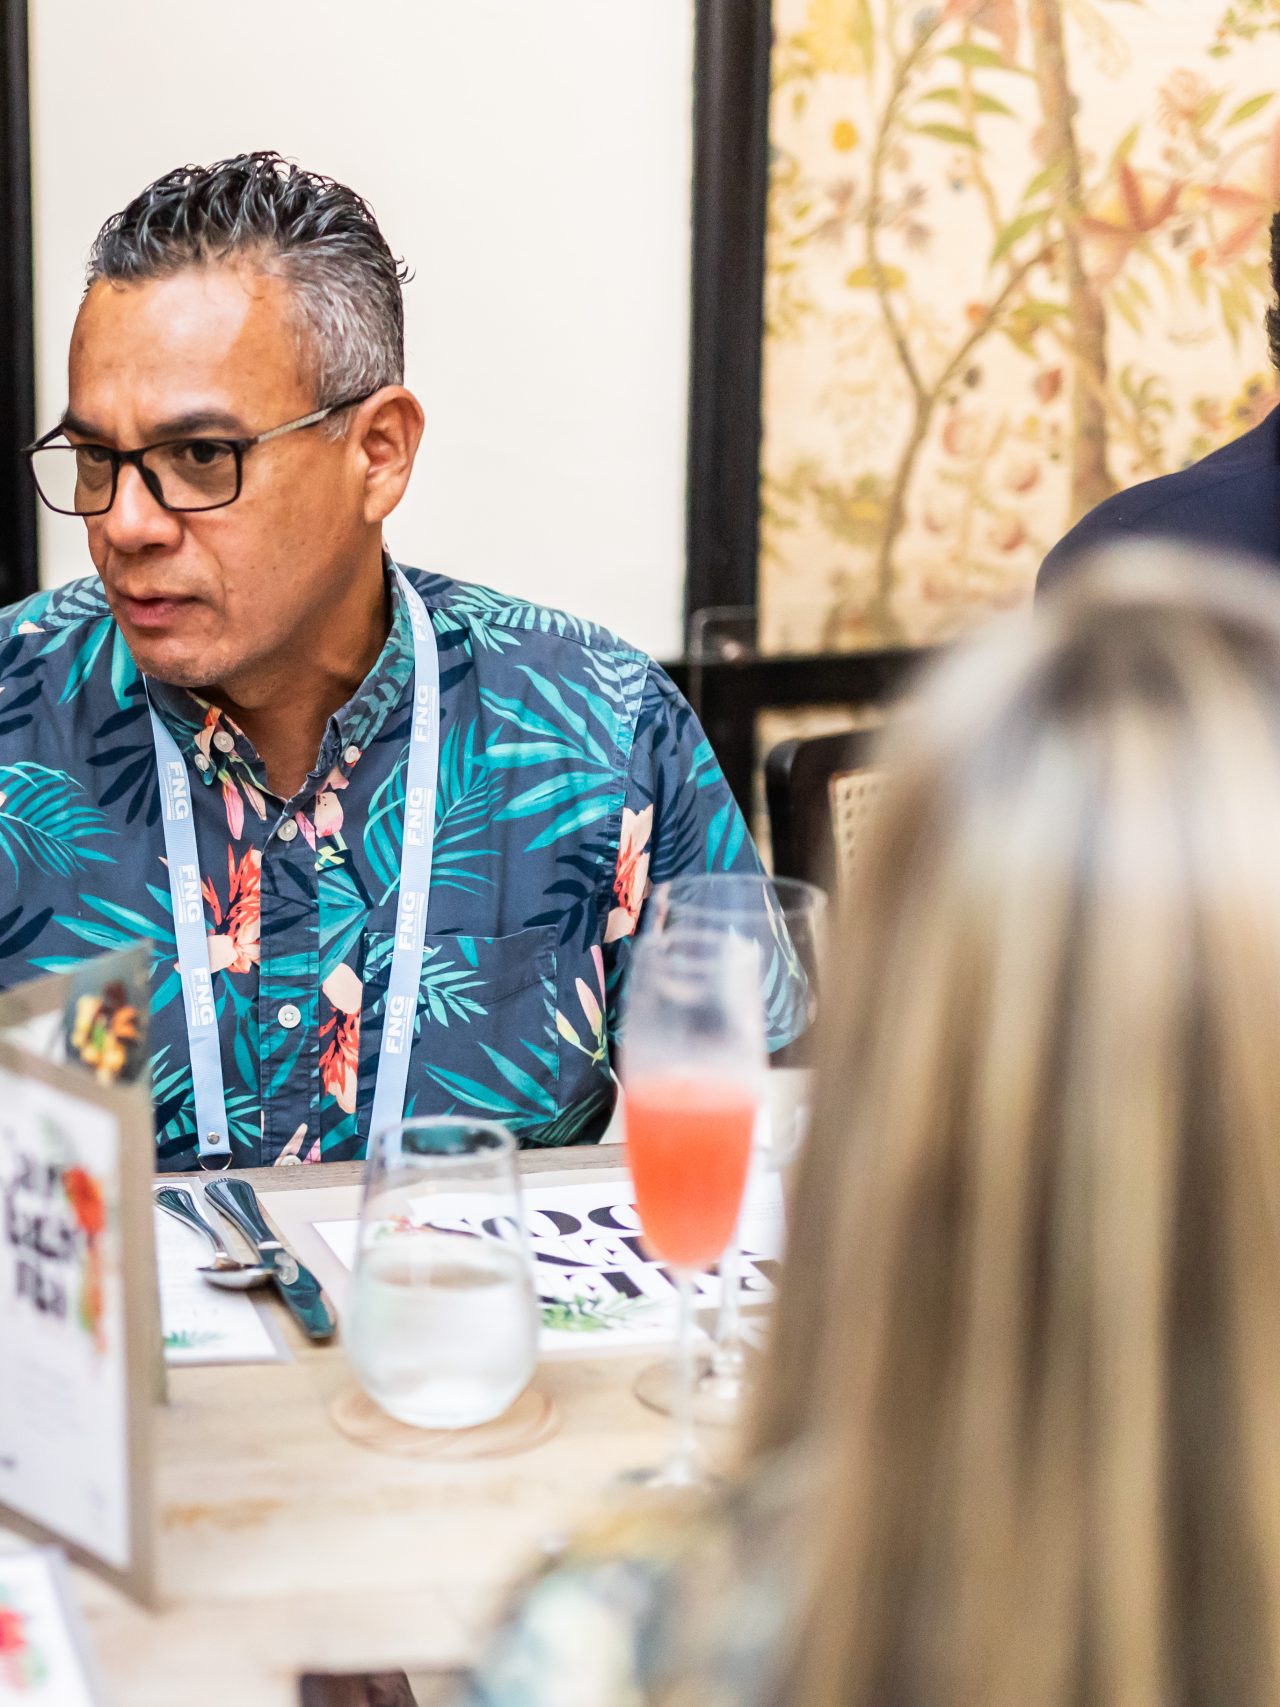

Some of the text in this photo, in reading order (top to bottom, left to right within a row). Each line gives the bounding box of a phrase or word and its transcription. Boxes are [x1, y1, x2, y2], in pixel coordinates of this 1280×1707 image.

[407, 591, 429, 641] FNG
[414, 684, 430, 743] FNG
[168, 761, 189, 821] FNG
[407, 786, 425, 847] FNG
[180, 864, 202, 923] FNG
[398, 891, 417, 951] FNG
[192, 966, 215, 1027] FNG
[385, 994, 406, 1055] FNG
